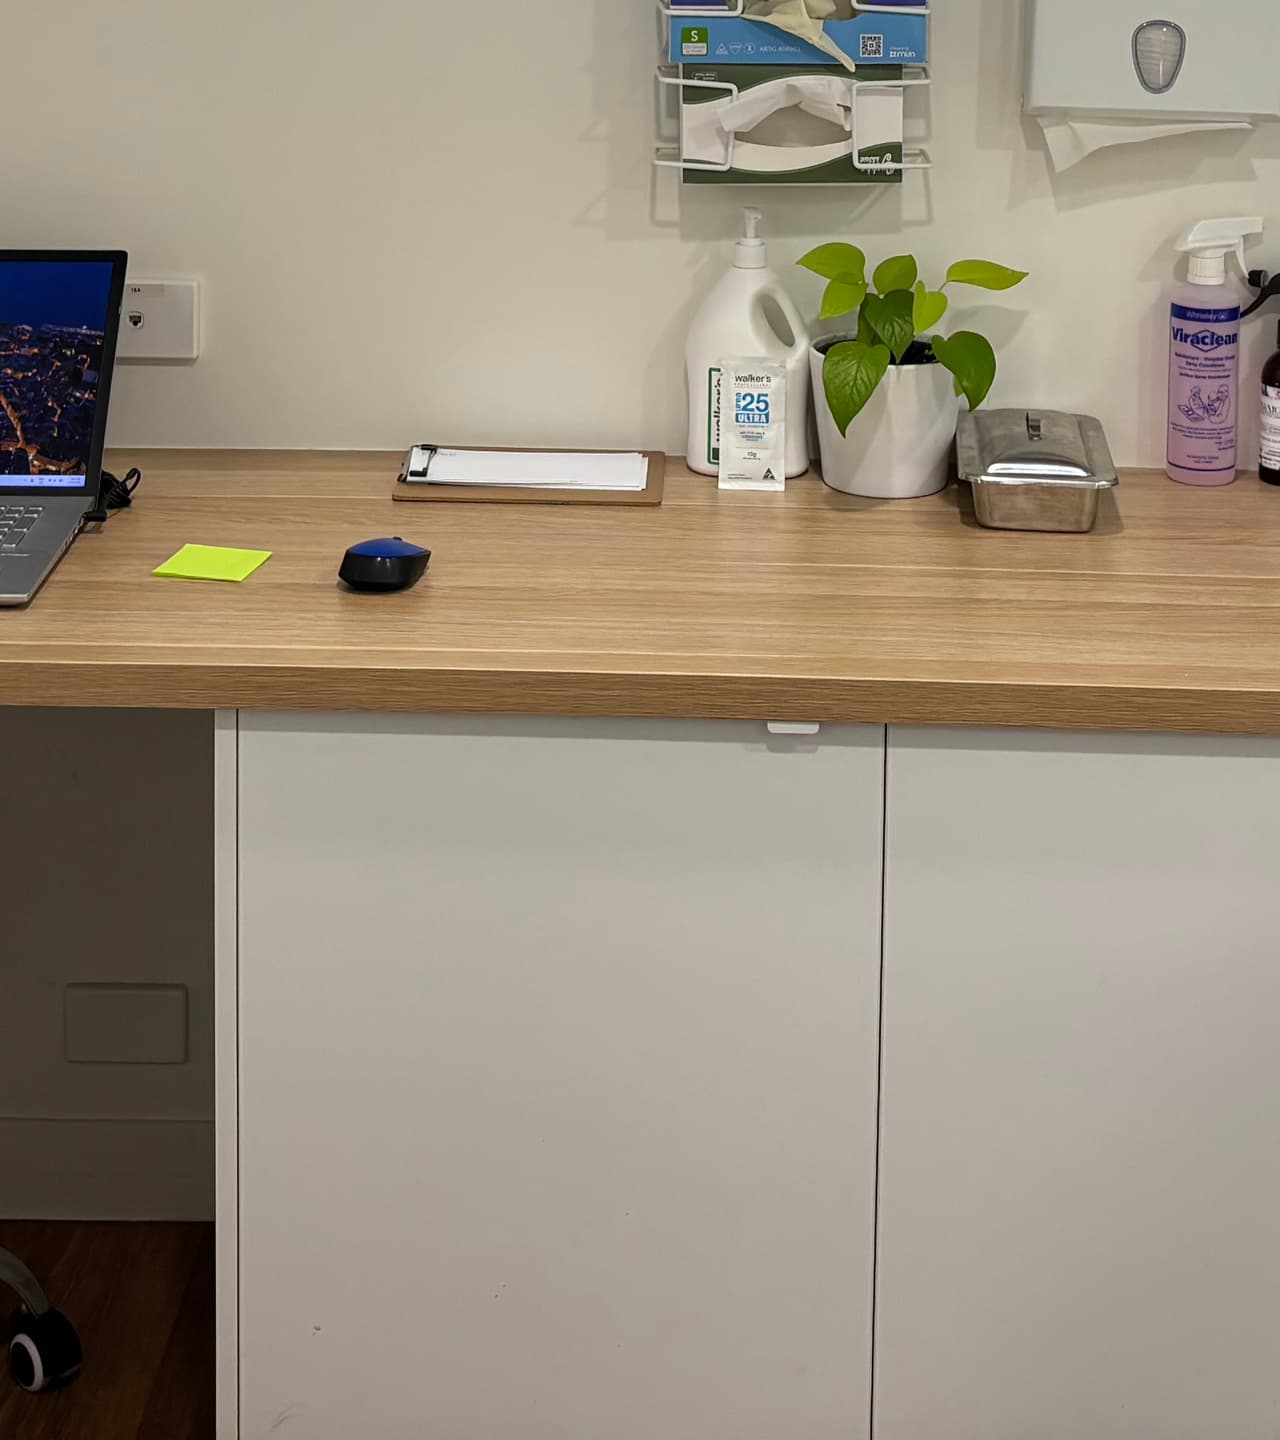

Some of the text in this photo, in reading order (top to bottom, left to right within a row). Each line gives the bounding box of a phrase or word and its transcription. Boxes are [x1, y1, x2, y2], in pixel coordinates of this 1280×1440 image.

[691, 30, 698, 41] S
[1172, 326, 1238, 346] Viraclean
[735, 374, 772, 383] walker's
[742, 392, 769, 412] 25
[738, 413, 766, 422] ULTRA
